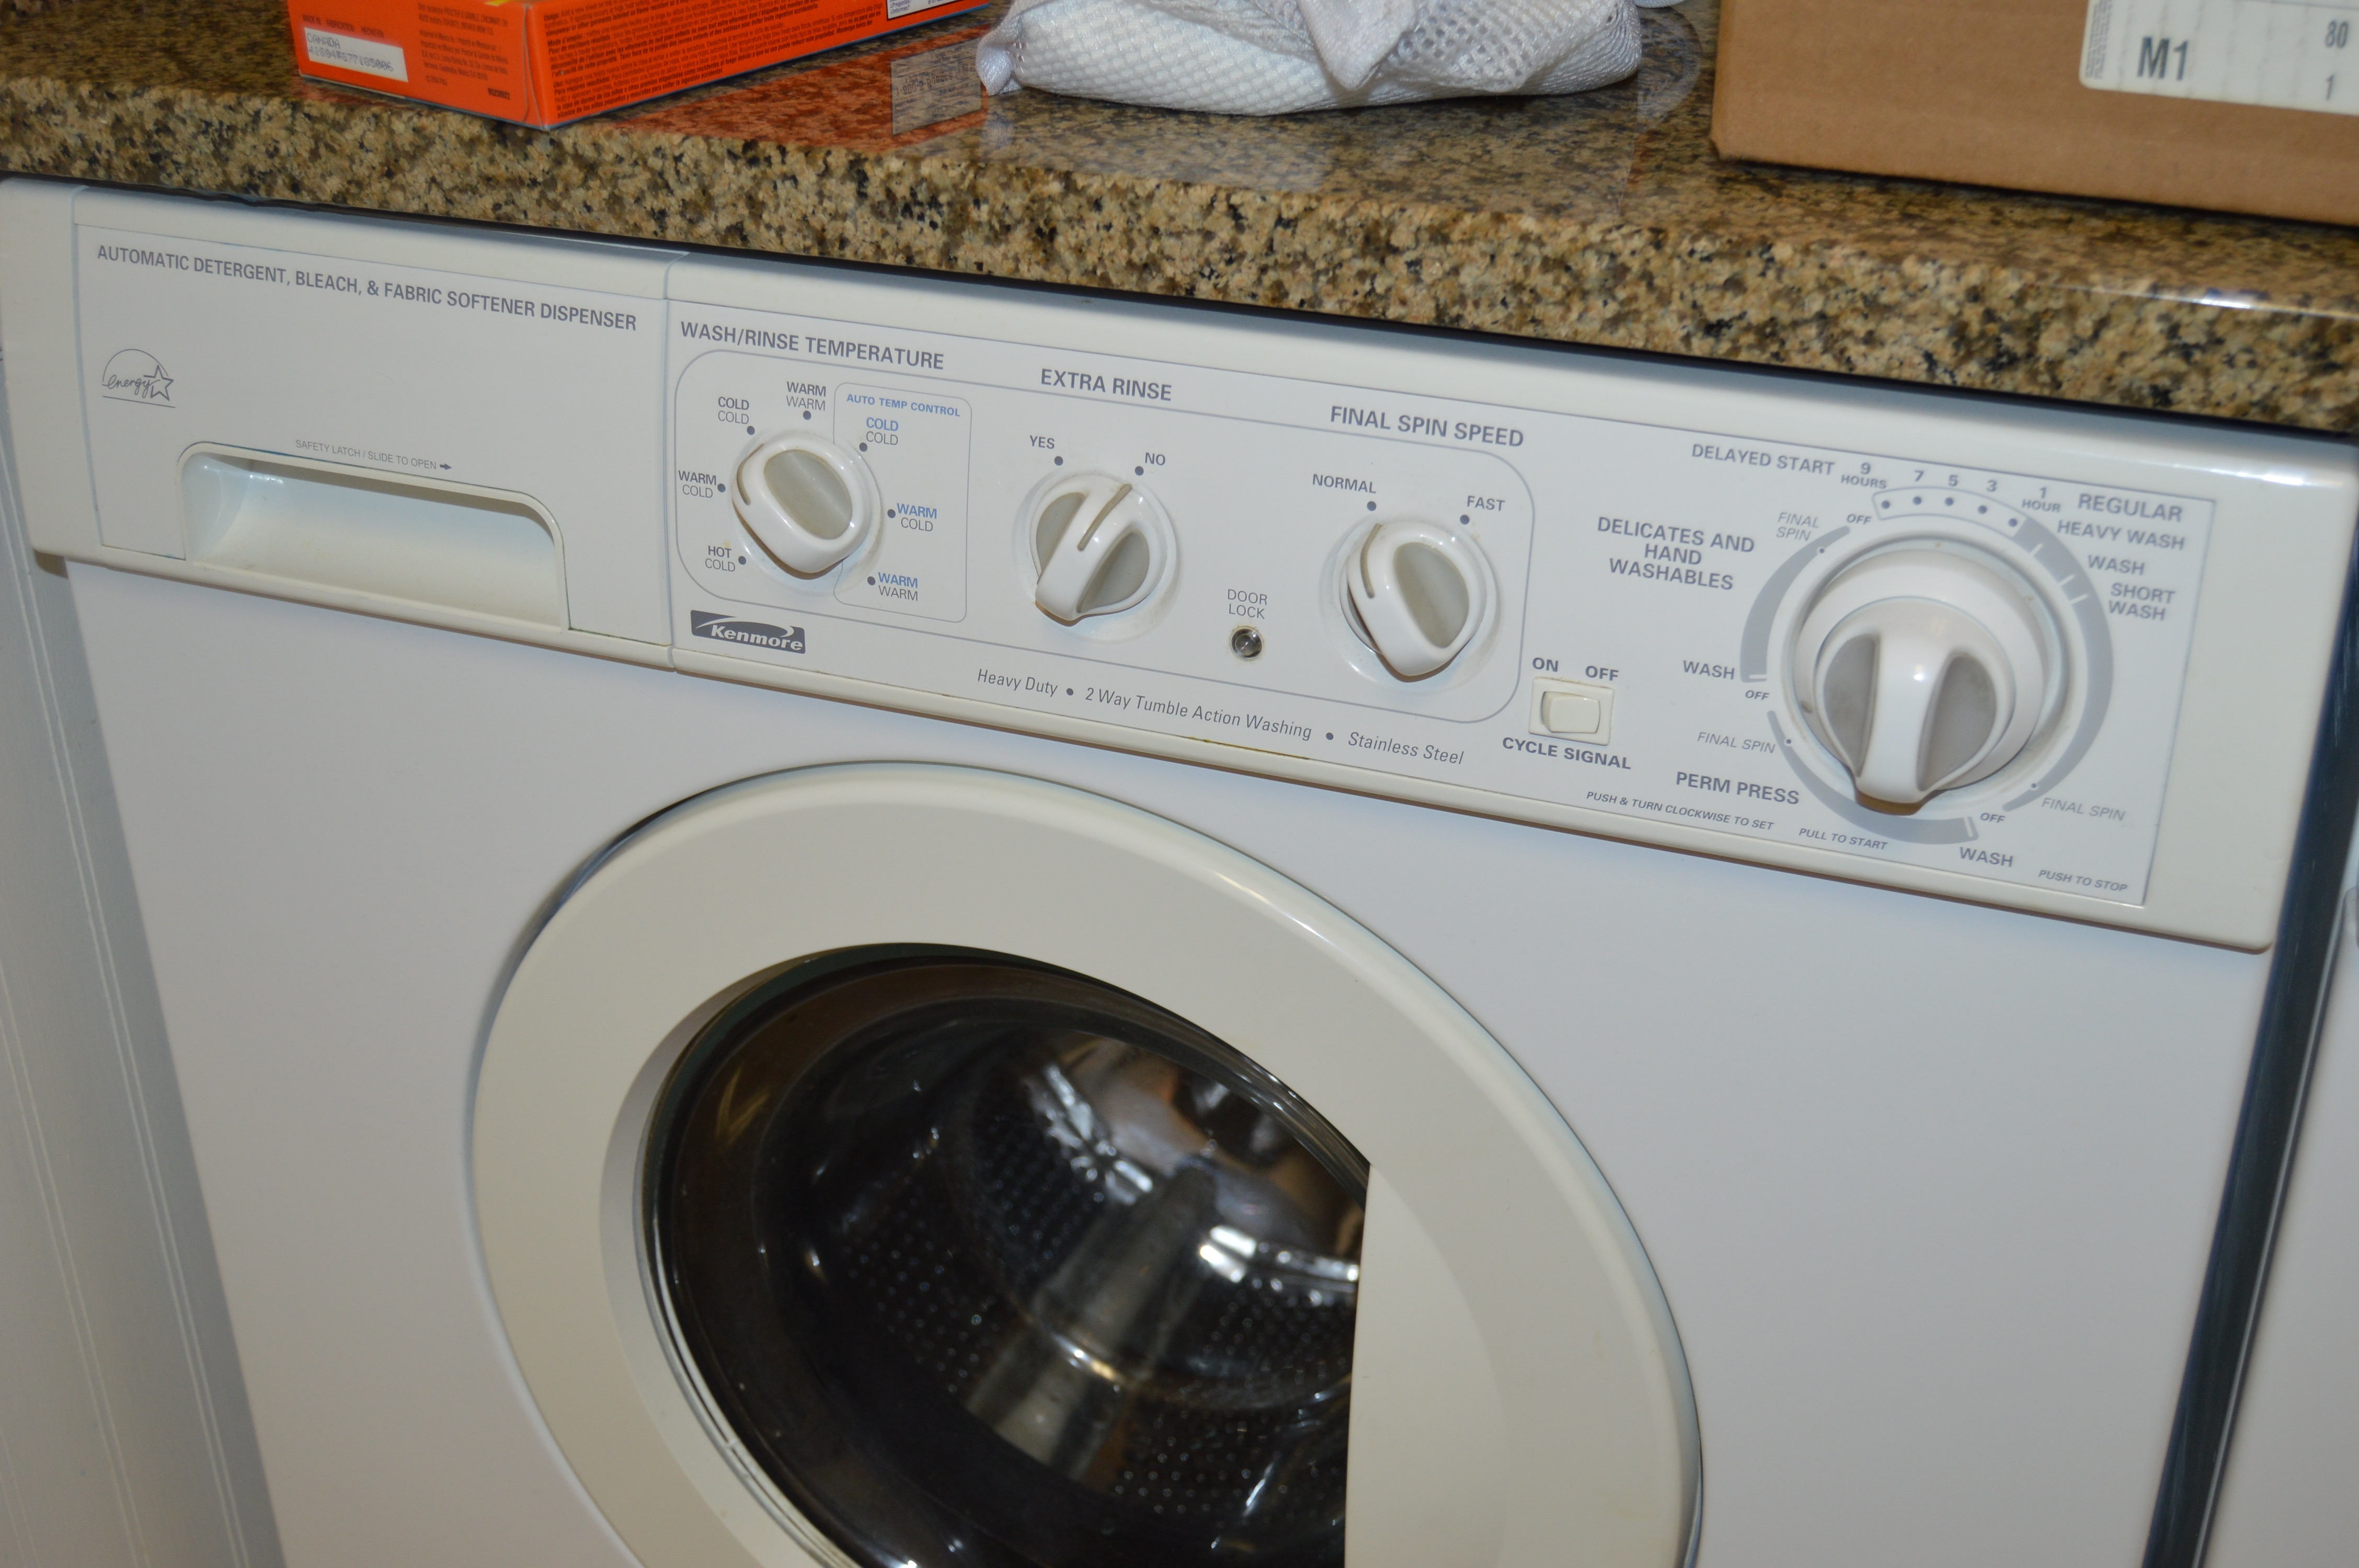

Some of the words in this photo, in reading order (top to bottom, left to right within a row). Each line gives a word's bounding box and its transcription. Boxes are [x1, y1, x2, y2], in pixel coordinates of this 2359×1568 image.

[307, 32, 341, 49] CANADA
[2324, 20, 2350, 50] 80
[2136, 35, 2190, 82] M1
[2325, 74, 2336, 101] 1
[98, 245, 189, 270] AUTOMATIC
[194, 257, 290, 285] DETERGENT,
[296, 271, 361, 295] BLEACH,
[367, 280, 379, 296] &
[385, 282, 441, 304] FABRIC
[447, 291, 535, 317] SOFTENER
[541, 303, 636, 330] DISPENSER
[681, 321, 799, 351] WASH/RINSE
[805, 337, 944, 370] TEMPERATURE
[787, 382, 826, 397] WARM
[1040, 368, 1106, 393] EXTRA
[1112, 377, 1172, 402] RINSE
[718, 397, 749, 410] COLD
[786, 396, 825, 411] WARM
[846, 394, 875, 405] AUTO
[879, 398, 907, 409] TEMP
[911, 402, 960, 417] CONTROL
[718, 411, 749, 424] COLD
[866, 417, 898, 431] COLD
[1331, 406, 1390, 430] FINAL
[1398, 415, 1447, 437] SPIN
[1454, 422, 1523, 446] SPEED
[866, 431, 898, 445] COLD
[1030, 435, 1055, 449] YES
[296, 440, 329, 452] SAFETY
[332, 446, 360, 457] LATCH
[368, 451, 393, 463] SLIDE
[396, 456, 408, 465] TO
[411, 458, 436, 469] OPEN
[1145, 453, 1165, 465] NO
[1692, 444, 1771, 466] DELAYED
[1777, 455, 1835, 475] START
[678, 470, 716, 489] WARM
[1313, 474, 1376, 493] NORMAL
[1841, 475, 1887, 489] HOURS
[1861, 463, 1871, 475] 9
[1915, 470, 1924, 481] 7
[1949, 475, 1958, 487] 5
[1987, 479, 1997, 492] 3
[2040, 487, 2047, 499] 1
[683, 485, 713, 498] COLD
[897, 503, 937, 522] WARM
[1467, 495, 1505, 511] FAST
[2022, 499, 2061, 513] HOUR
[2078, 493, 2183, 522] REGULAR
[901, 517, 933, 532] COLD
[1778, 512, 1819, 531] FINAL
[1847, 514, 1872, 524] OFF
[1598, 517, 1704, 546] DELICATES
[1710, 534, 1755, 552] AND
[1776, 526, 1811, 541] SPIN
[2057, 520, 2122, 540] HEAVY
[2127, 529, 2185, 550] WASH
[708, 546, 731, 558] HOT
[1644, 544, 1702, 569] HAND
[705, 558, 735, 572] COLD
[1610, 556, 1733, 590] WASHABLES
[2088, 555, 2145, 575] WASH
[878, 572, 918, 591] WARM
[878, 585, 918, 601] WARM
[1228, 589, 1267, 605] DOOR
[2111, 583, 2176, 604] SHORT
[1229, 604, 1264, 619] LOCK
[2109, 601, 2167, 620] WASH
[711, 625, 804, 652] Kenmore
[1532, 658, 1558, 672] ON
[1585, 666, 1619, 681] OFF
[1683, 661, 1735, 679] WASH
[1745, 690, 1769, 700] OFF
[978, 669, 1021, 691] Heavy
[1025, 677, 1058, 697] Duty
[1085, 688, 1094, 700] 2
[1100, 689, 1131, 710] Way
[1137, 695, 1187, 717] Tumble
[1192, 706, 1240, 725] Action
[1247, 714, 1311, 741] Washing
[1348, 732, 1418, 756] Stainless
[1424, 745, 1464, 764] Steel
[1698, 732, 1736, 747] FINAL
[1742, 740, 1776, 753] SPIN
[1503, 737, 1558, 757] CYCLE
[1564, 748, 1631, 769] SIGNAL
[1677, 772, 1730, 793] PERM
[1737, 782, 1799, 804] PRESS
[1587, 792, 1617, 803] PUSH
[1633, 799, 1663, 811] TURN
[1665, 805, 1731, 823] CLOCKWISE
[1735, 816, 1749, 826] TO
[1751, 820, 1774, 829] SET
[1980, 813, 2005, 823] OFF
[2042, 798, 2083, 814] FINAL
[2089, 806, 2126, 821] SPIN
[1799, 828, 1826, 840] PULL
[1832, 834, 1847, 843] TO
[1849, 837, 1888, 849] START
[1960, 847, 2013, 867] WASH
[2039, 870, 2072, 882] PUSH
[2076, 876, 2092, 886] TO
[2094, 880, 2128, 891] STOP
